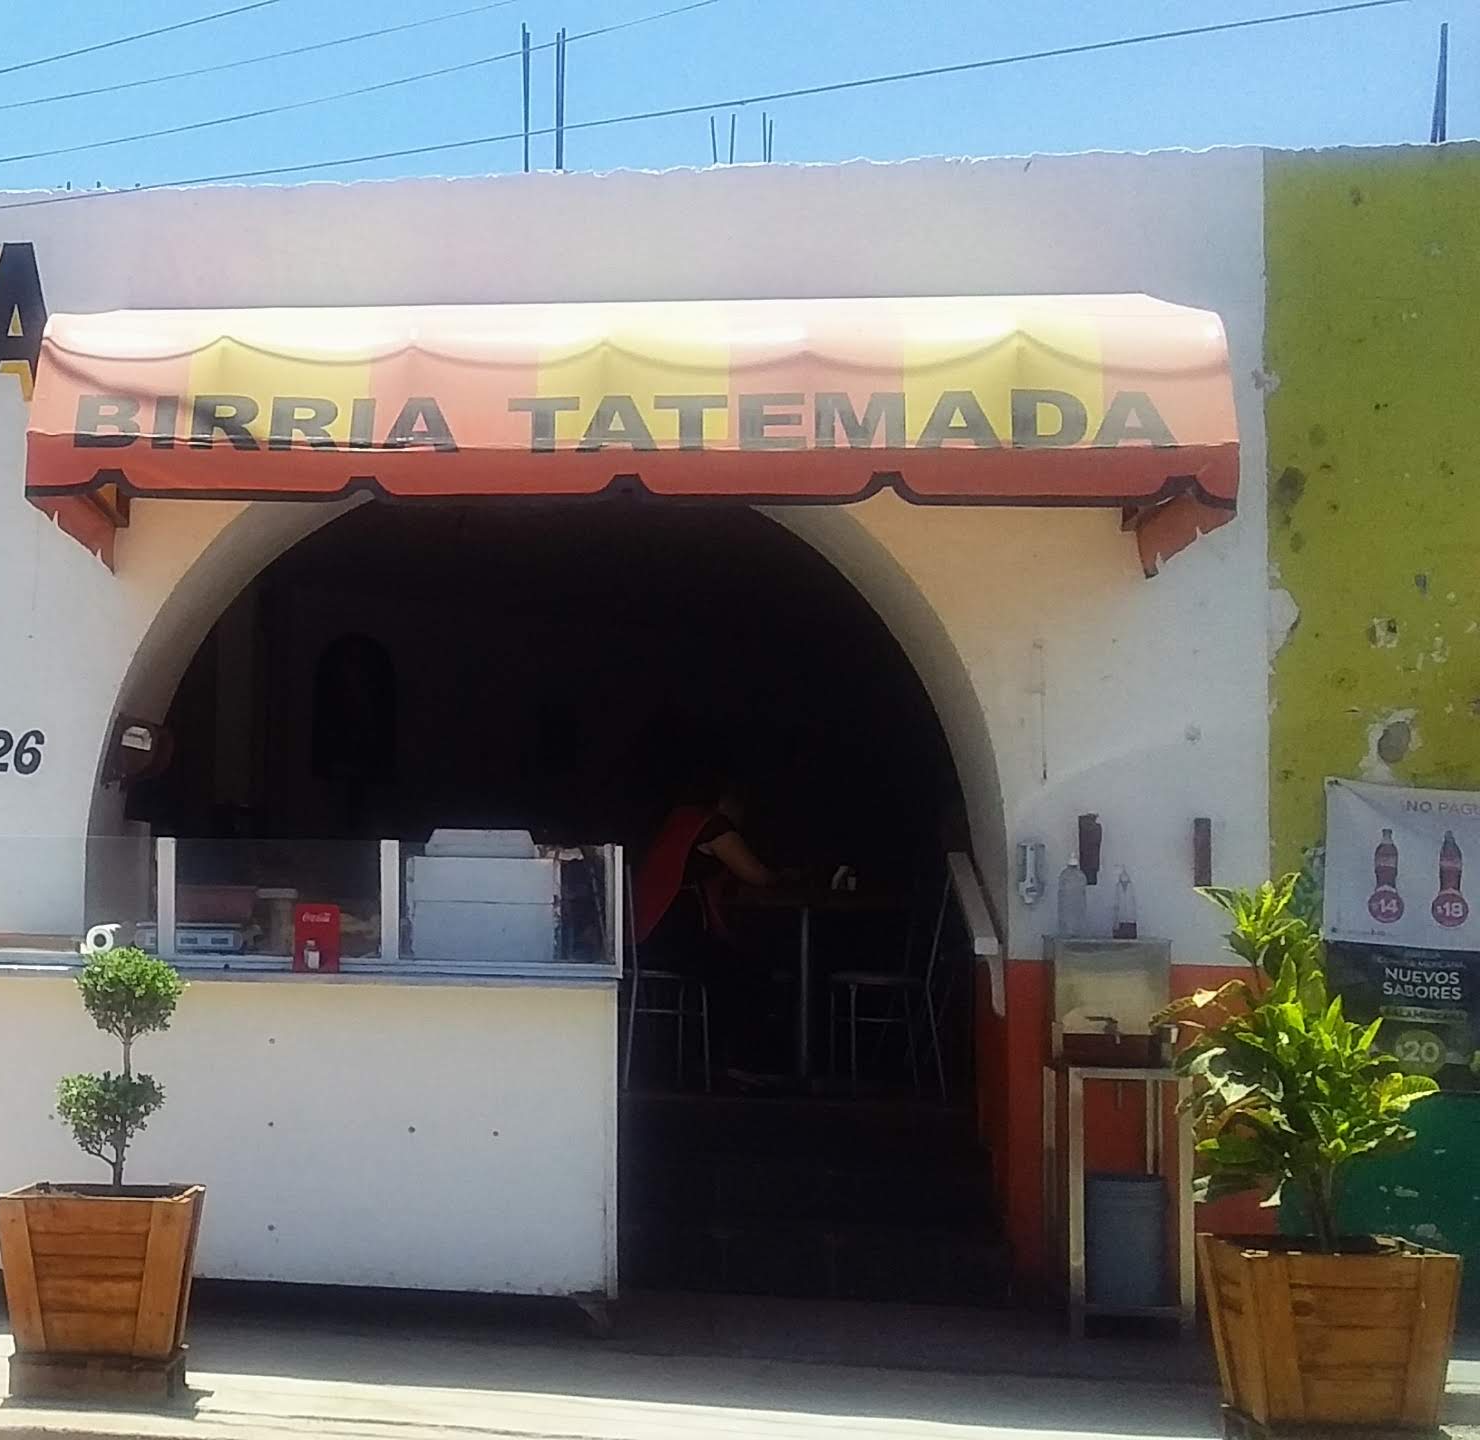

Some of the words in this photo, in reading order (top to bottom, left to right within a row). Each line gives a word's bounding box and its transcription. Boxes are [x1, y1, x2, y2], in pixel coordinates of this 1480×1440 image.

[74, 394, 460, 453] BIRRIA
[508, 389, 1181, 453] TATEMADA
[1405, 799, 1432, 814] NO
[1384, 967, 1461, 985] NUEVOS
[1382, 981, 1463, 1001] SABORES
